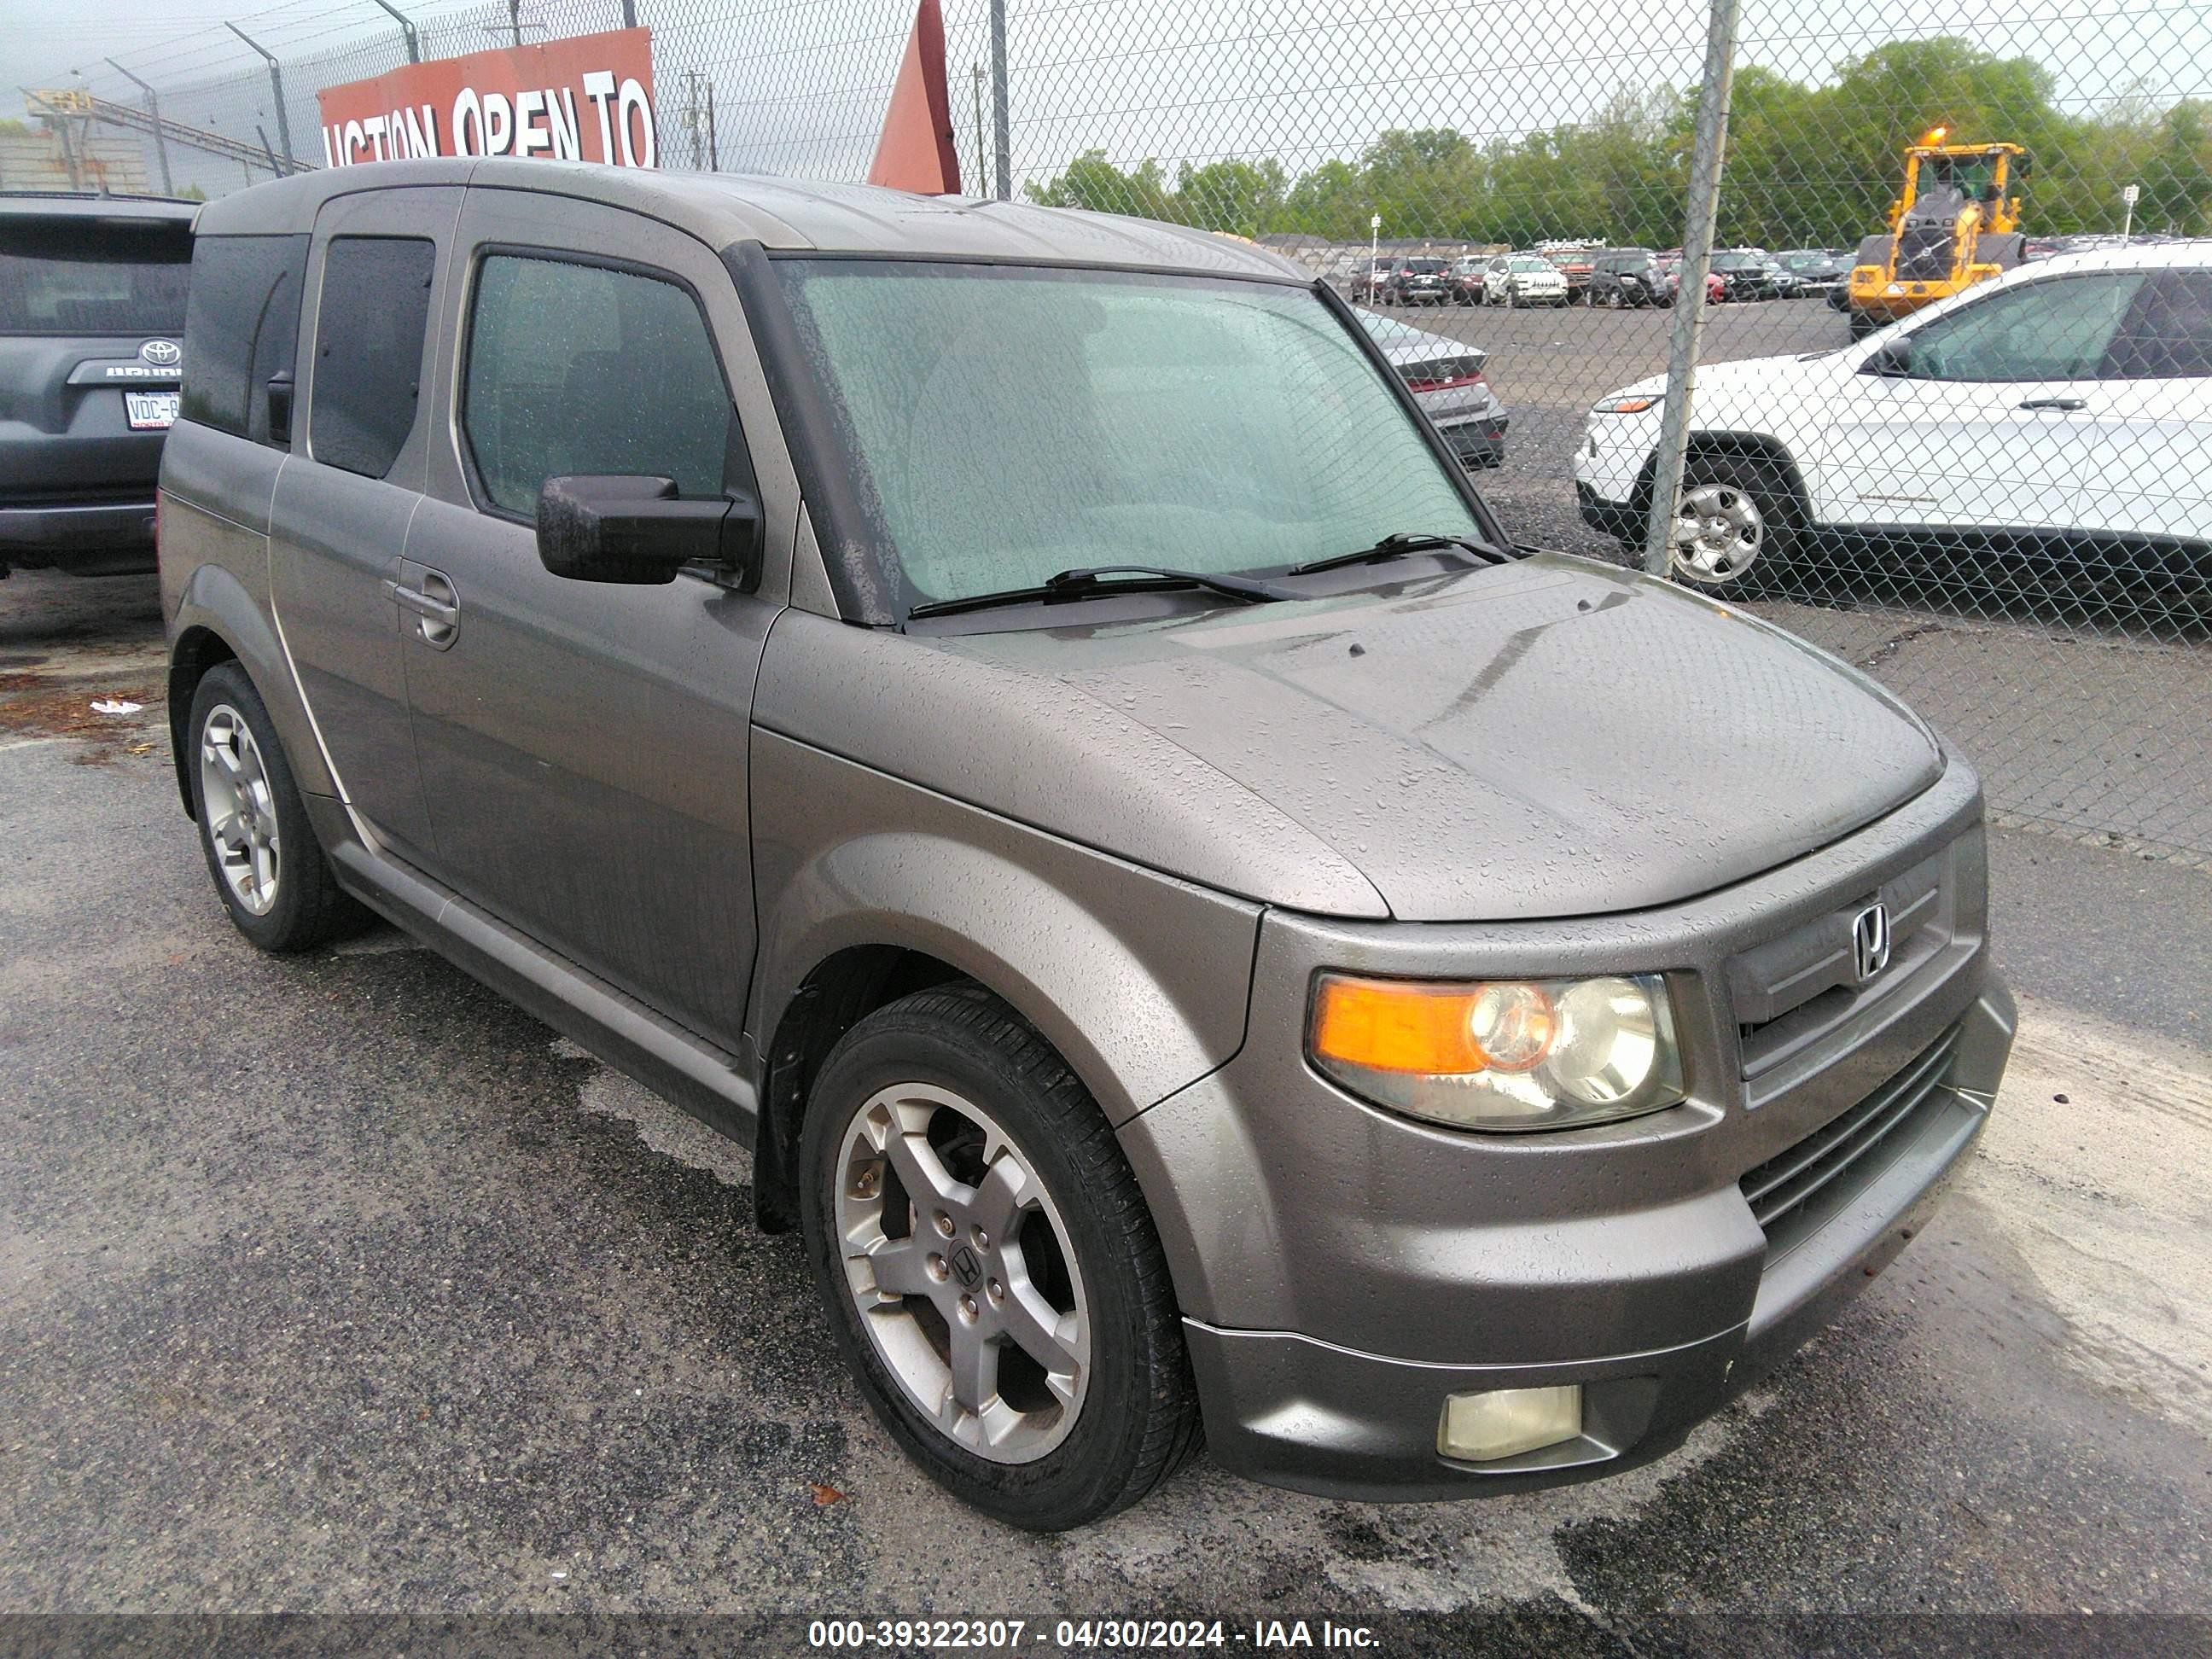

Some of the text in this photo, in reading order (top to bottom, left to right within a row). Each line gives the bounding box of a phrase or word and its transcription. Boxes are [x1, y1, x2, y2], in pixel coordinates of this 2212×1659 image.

[323, 70, 656, 169] UCTION OPEN TO
